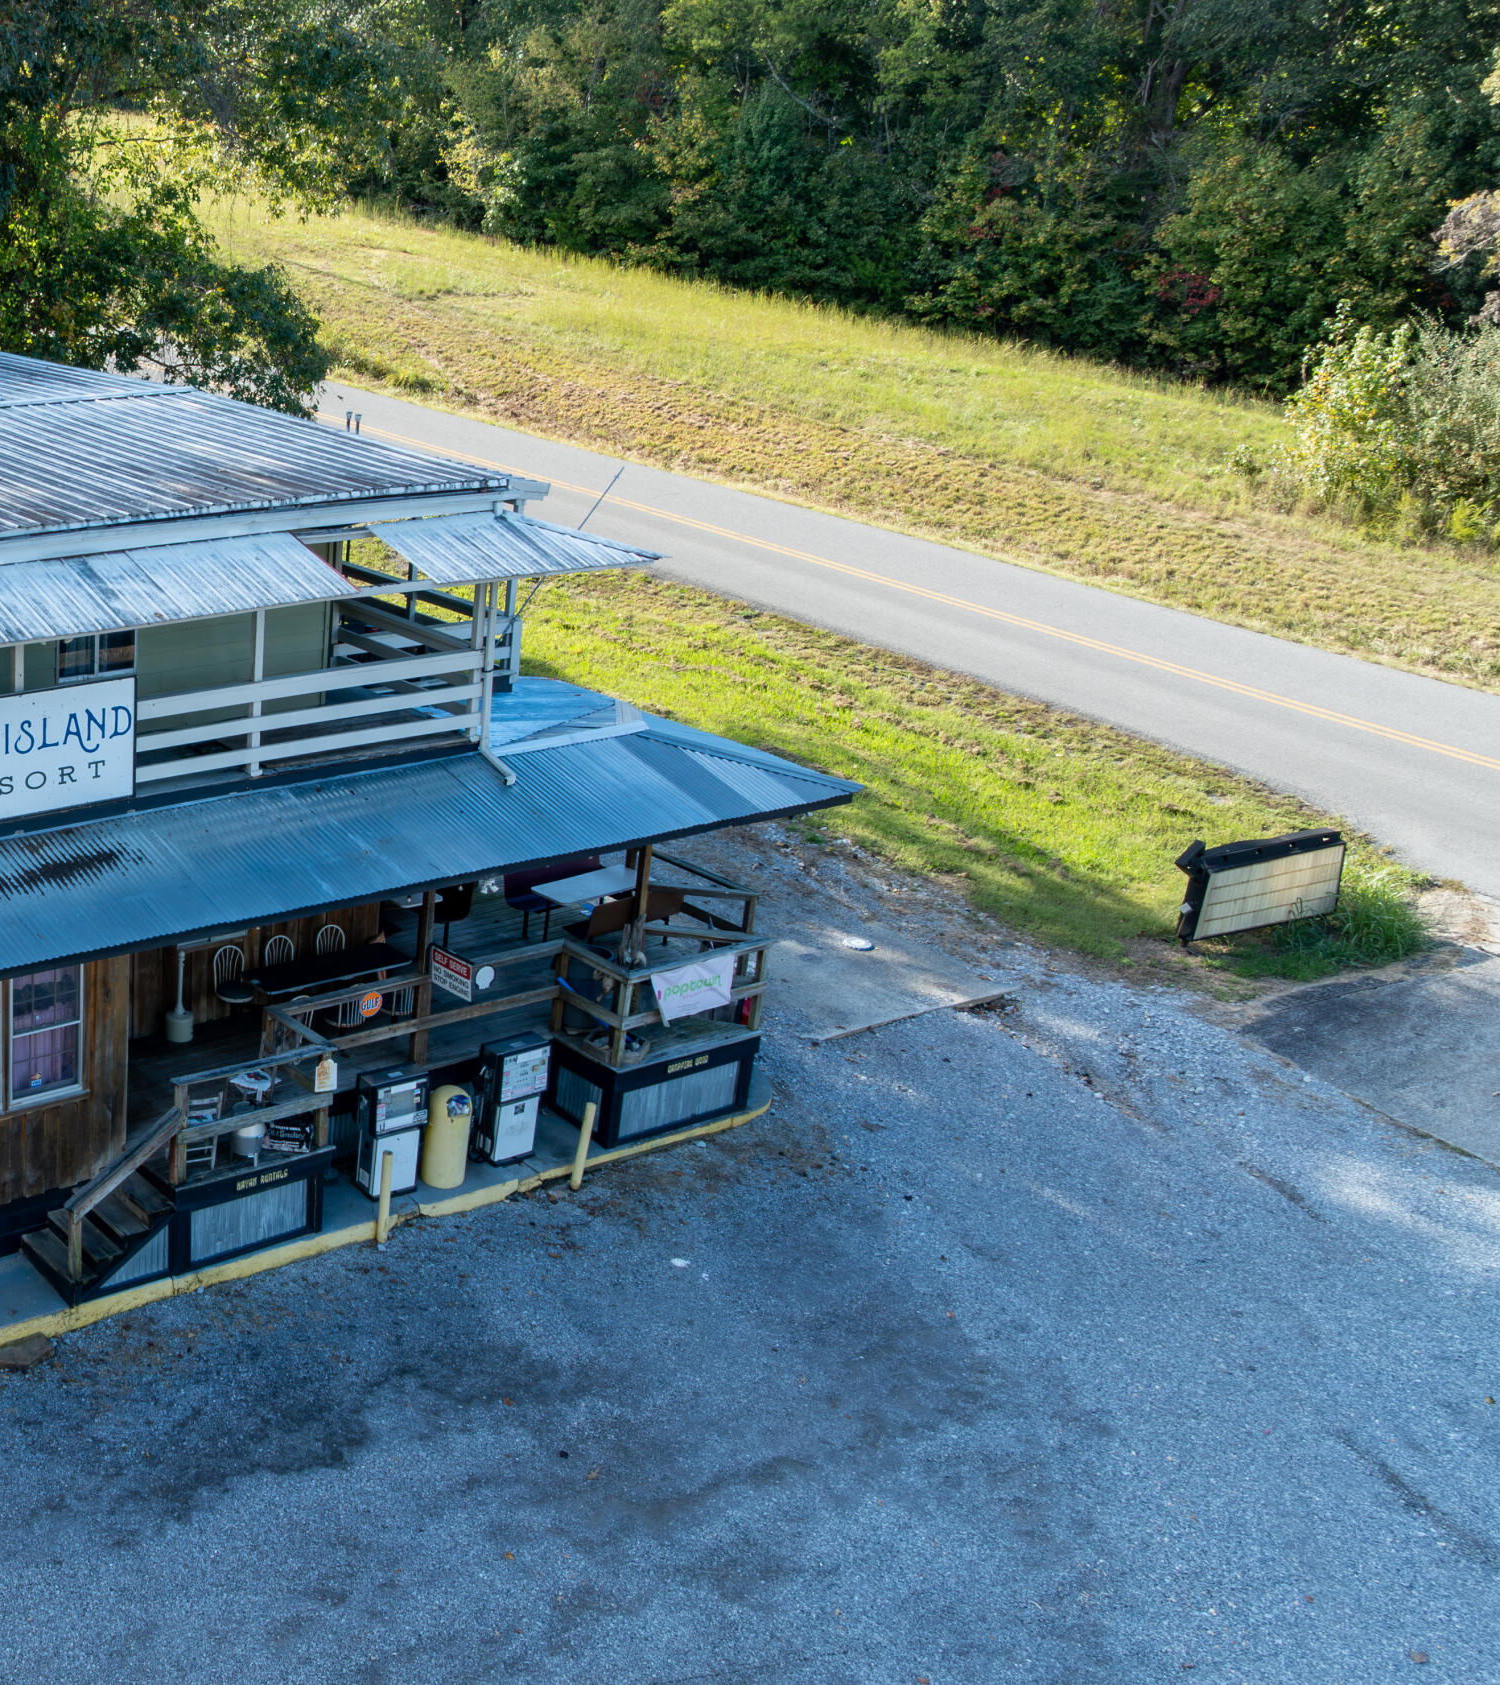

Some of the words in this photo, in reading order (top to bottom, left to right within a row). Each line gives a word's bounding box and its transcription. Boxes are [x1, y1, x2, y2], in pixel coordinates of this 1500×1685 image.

[4, 705, 132, 754] ISLAND
[435, 952, 449, 965] SELF
[450, 960, 468, 976] SERVE
[434, 964, 442, 974] NO
[443, 969, 469, 989] SMOKING
[434, 974, 448, 984] STOP
[449, 981, 469, 998] ENGINE
[362, 997, 380, 1011] GULF
